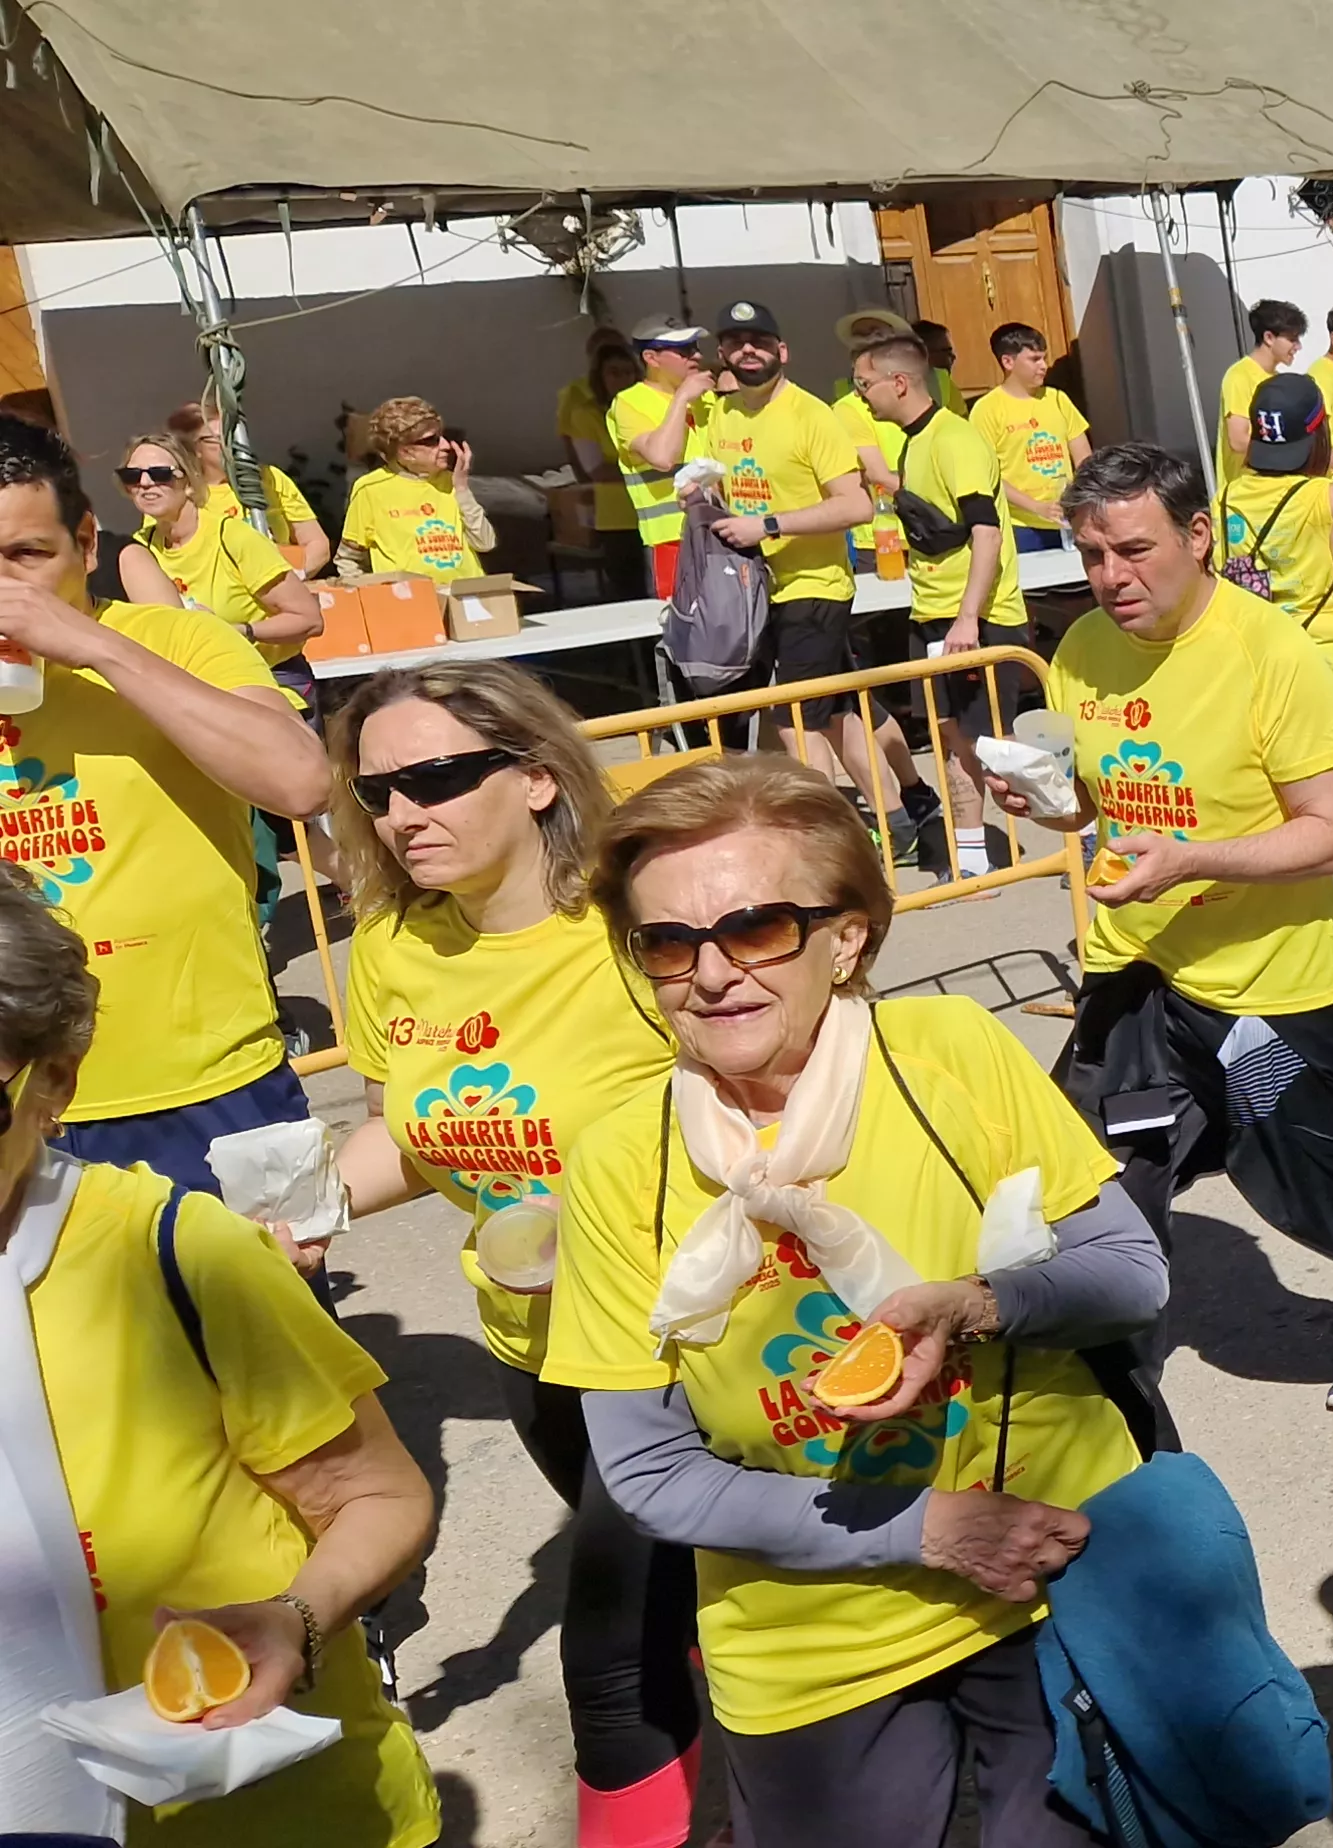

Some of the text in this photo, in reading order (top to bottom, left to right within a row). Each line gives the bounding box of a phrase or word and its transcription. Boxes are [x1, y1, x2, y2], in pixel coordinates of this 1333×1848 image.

[1257, 409, 1287, 443] H
[1079, 700, 1097, 721] 13
[1097, 777, 1194, 807] LA SUERTE DE
[72, 799, 99, 827] DE
[1101, 801, 1198, 828] CONOCERNOS
[388, 1016, 416, 1046] 13
[405, 1118, 553, 1148] LA SUERTE DE
[418, 1149, 562, 1177] CONOCERNOS
[758, 1379, 806, 1421] LA
